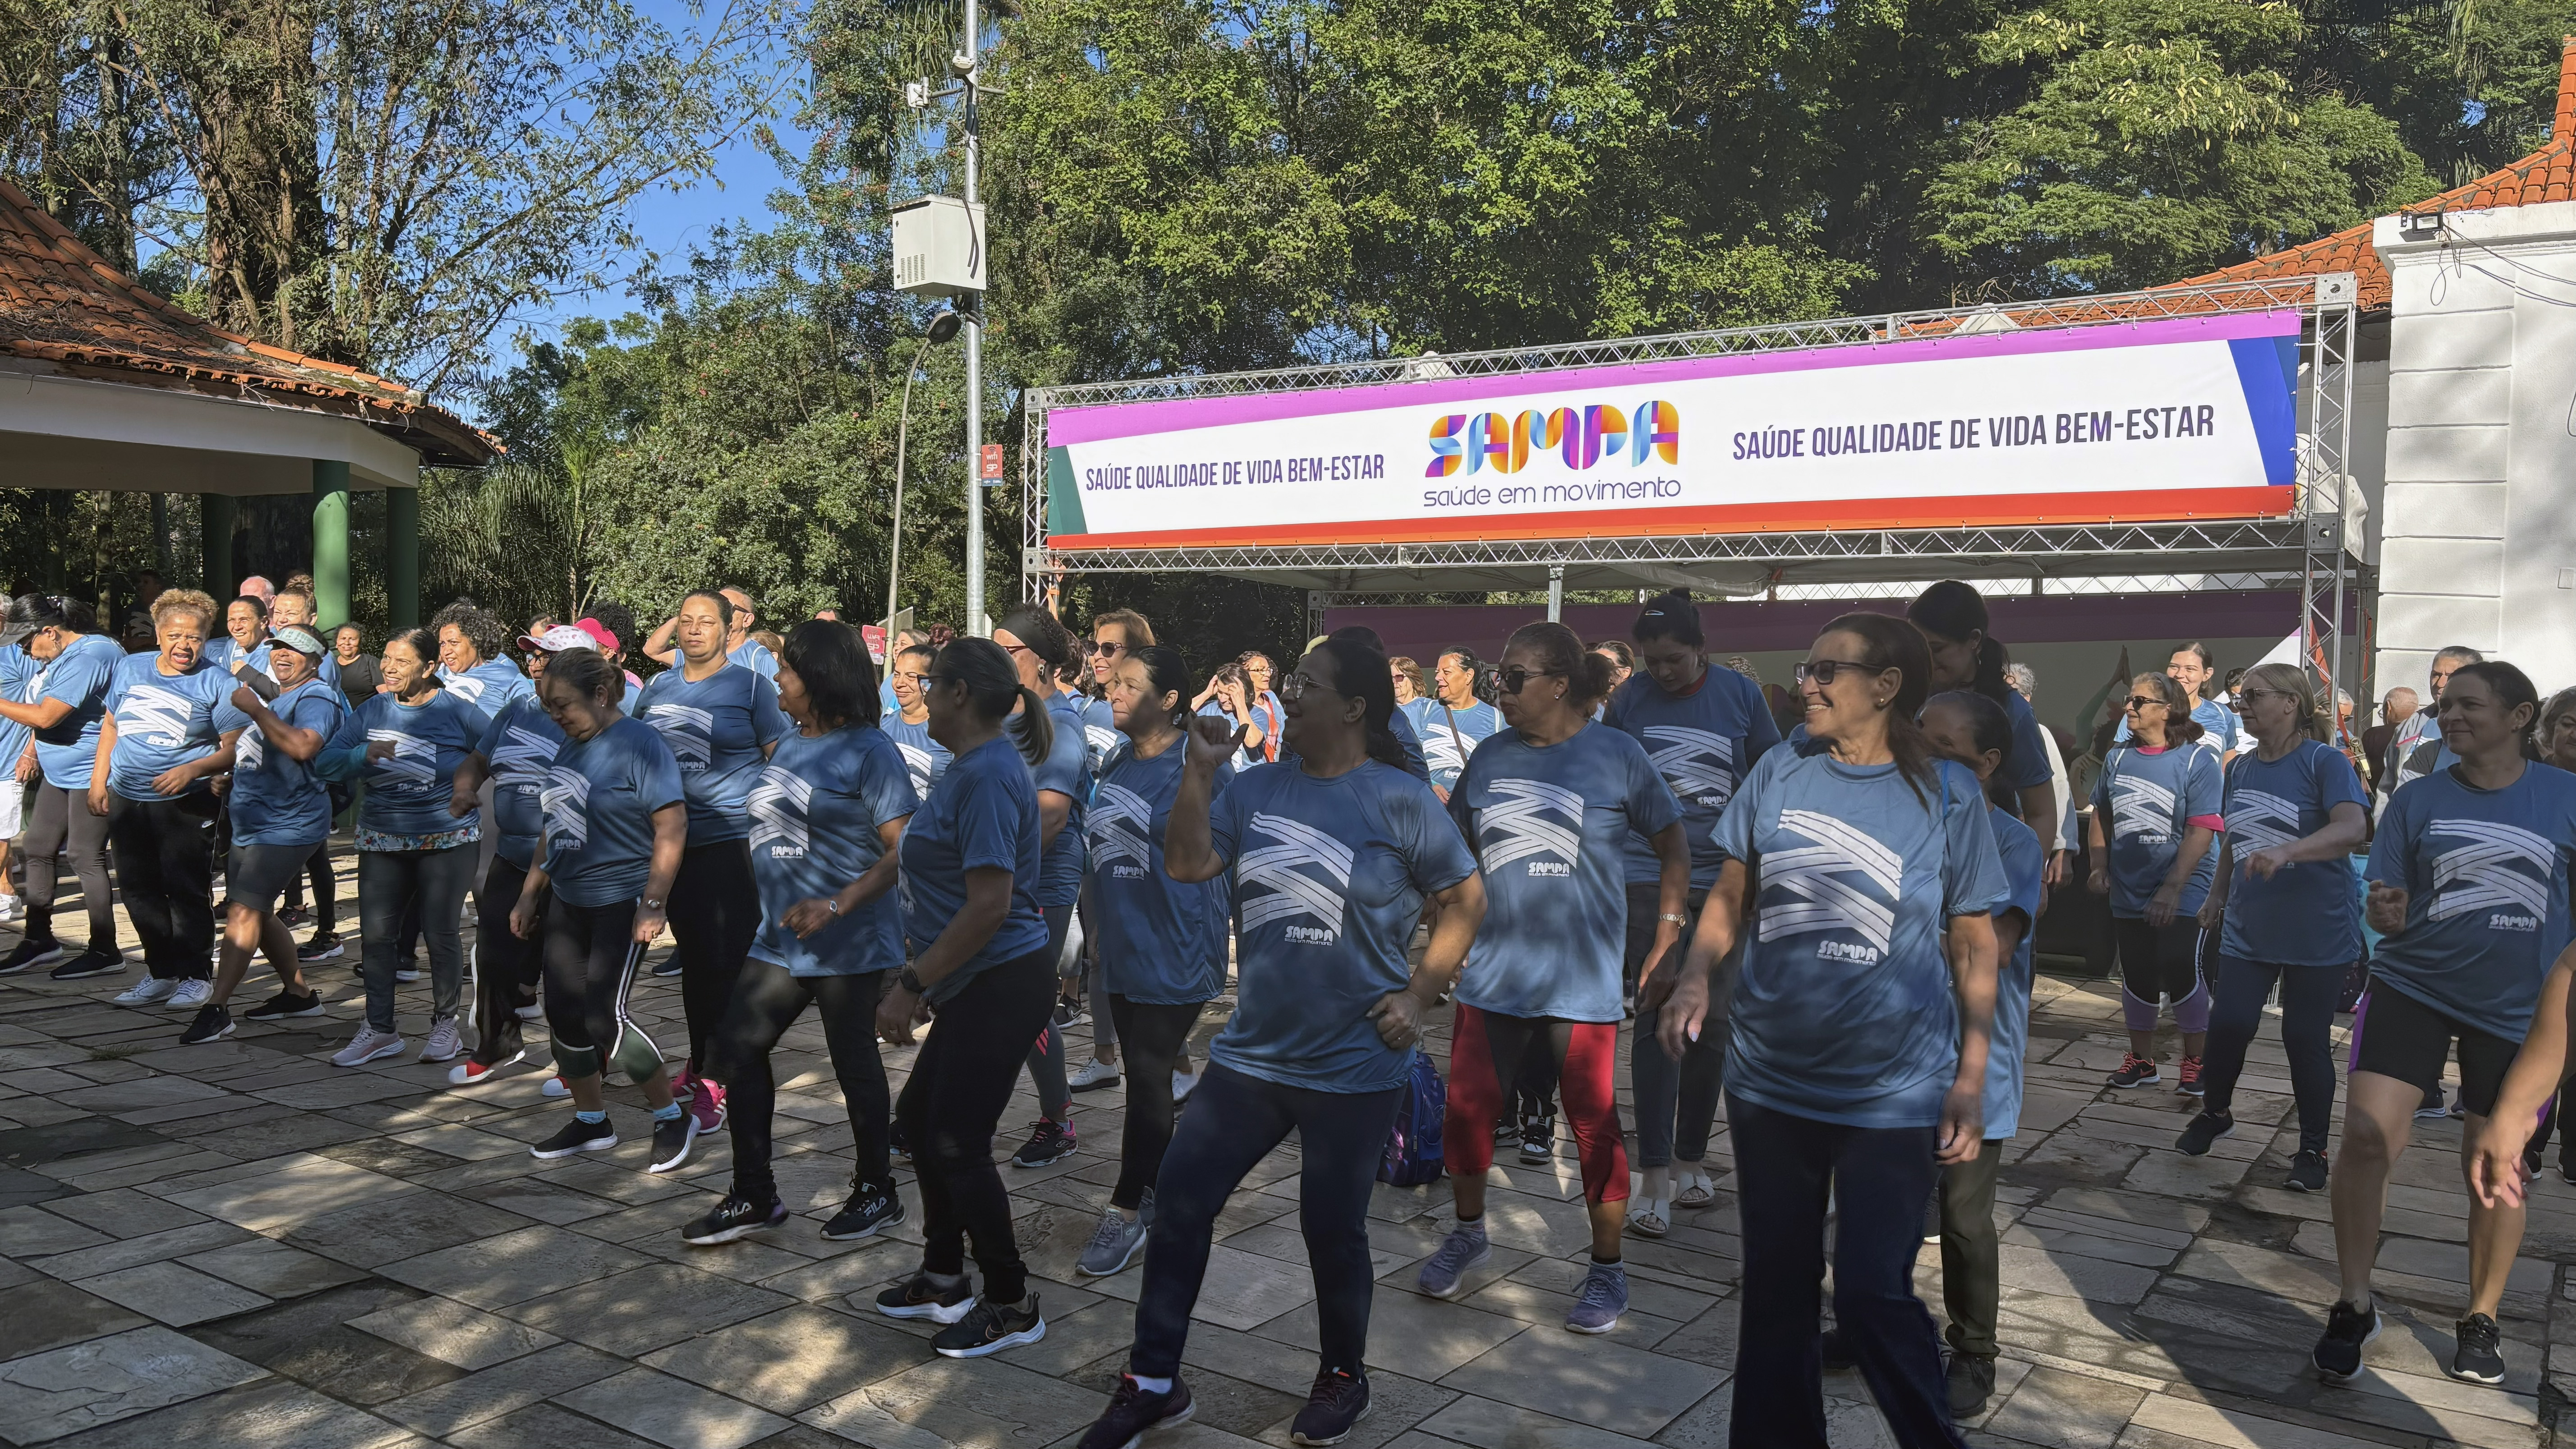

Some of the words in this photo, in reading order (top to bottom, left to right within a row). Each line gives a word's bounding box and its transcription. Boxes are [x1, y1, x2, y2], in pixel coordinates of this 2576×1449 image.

[1425, 400, 1679, 477] SAMPA
[1733, 425, 1805, 460] SAÚDE
[1813, 421, 1942, 457] QUALIDADE
[1950, 419, 1981, 449] DE
[1989, 415, 2047, 446] VIDA
[2056, 405, 2214, 444] BEM-ESTAR
[1086, 463, 1132, 491] SAÚDE
[1136, 462, 1218, 489] QUALIDADE
[1223, 461, 1242, 485] DE
[1247, 460, 1283, 484] VIDA
[1288, 454, 1384, 482] BEM-ESTAR
[1424, 485, 1490, 507] saúde
[1498, 486, 1536, 503] em
[1543, 476, 1681, 502] movimento
[1529, 862, 1569, 874] SAMPA
[1285, 925, 1333, 942] SAMPA
[2489, 914, 2537, 929] SAMPA
[1818, 940, 1877, 962] SAMPA
